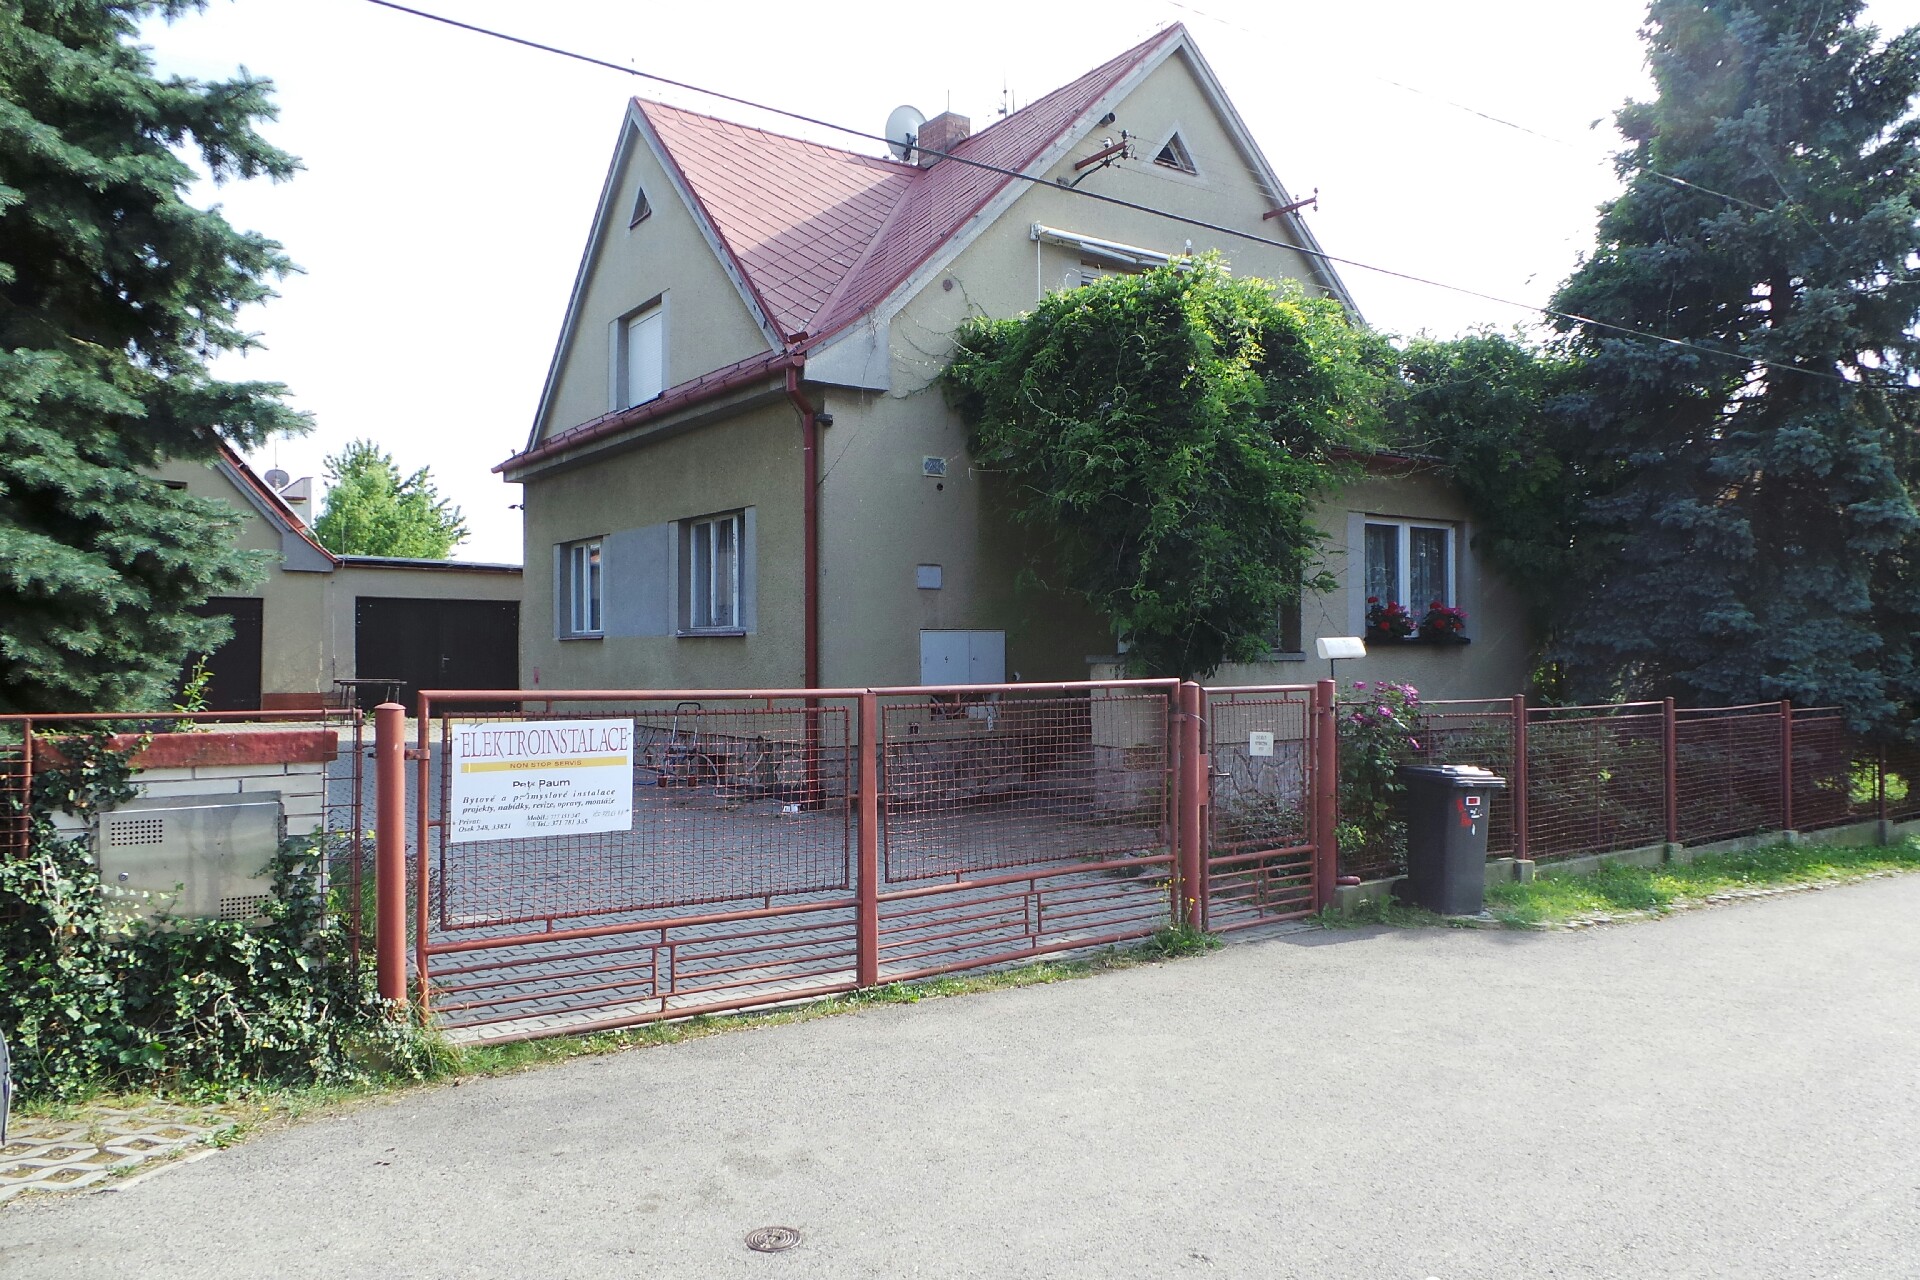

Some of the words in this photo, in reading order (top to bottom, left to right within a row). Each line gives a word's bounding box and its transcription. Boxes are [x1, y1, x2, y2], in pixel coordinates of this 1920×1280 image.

[460, 727, 628, 758] ELEKTROINSTALACE
[463, 796, 495, 805] Bytové
[573, 789, 615, 798] instalace
